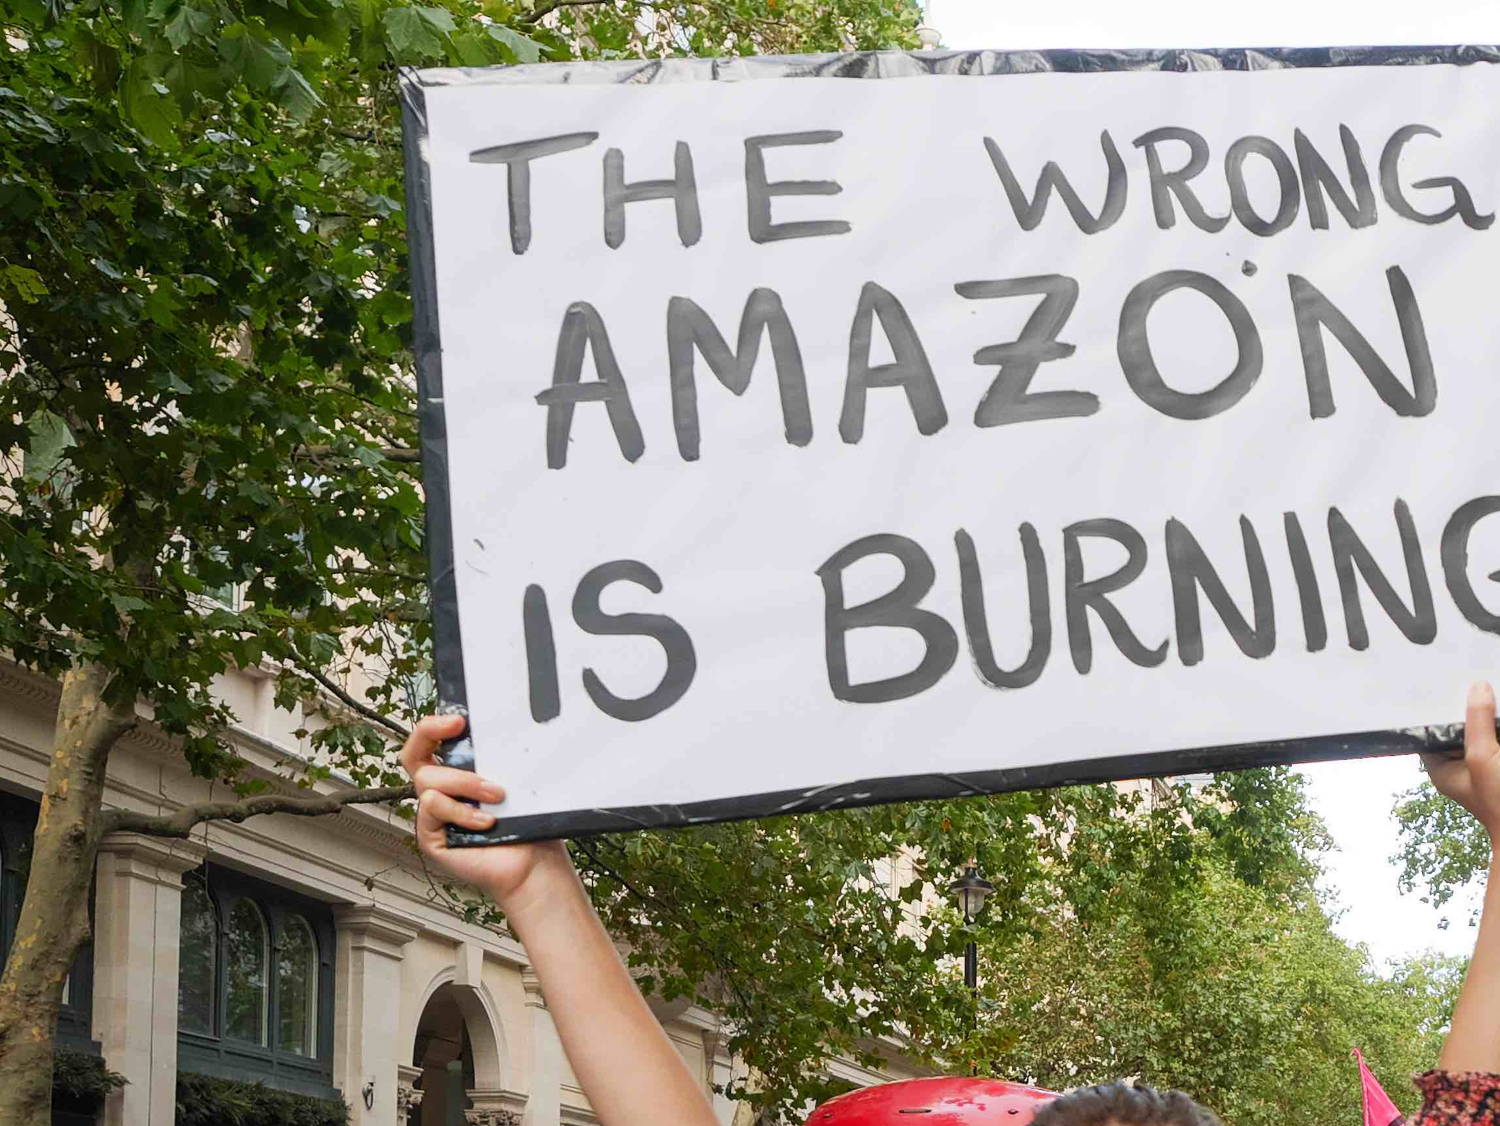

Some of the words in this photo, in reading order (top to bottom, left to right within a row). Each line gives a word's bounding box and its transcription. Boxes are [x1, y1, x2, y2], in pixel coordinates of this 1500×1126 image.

[469, 129, 853, 254] THE
[983, 123, 1496, 235] WRONG
[534, 262, 1438, 470] AMAZON
[523, 558, 698, 725] IS
